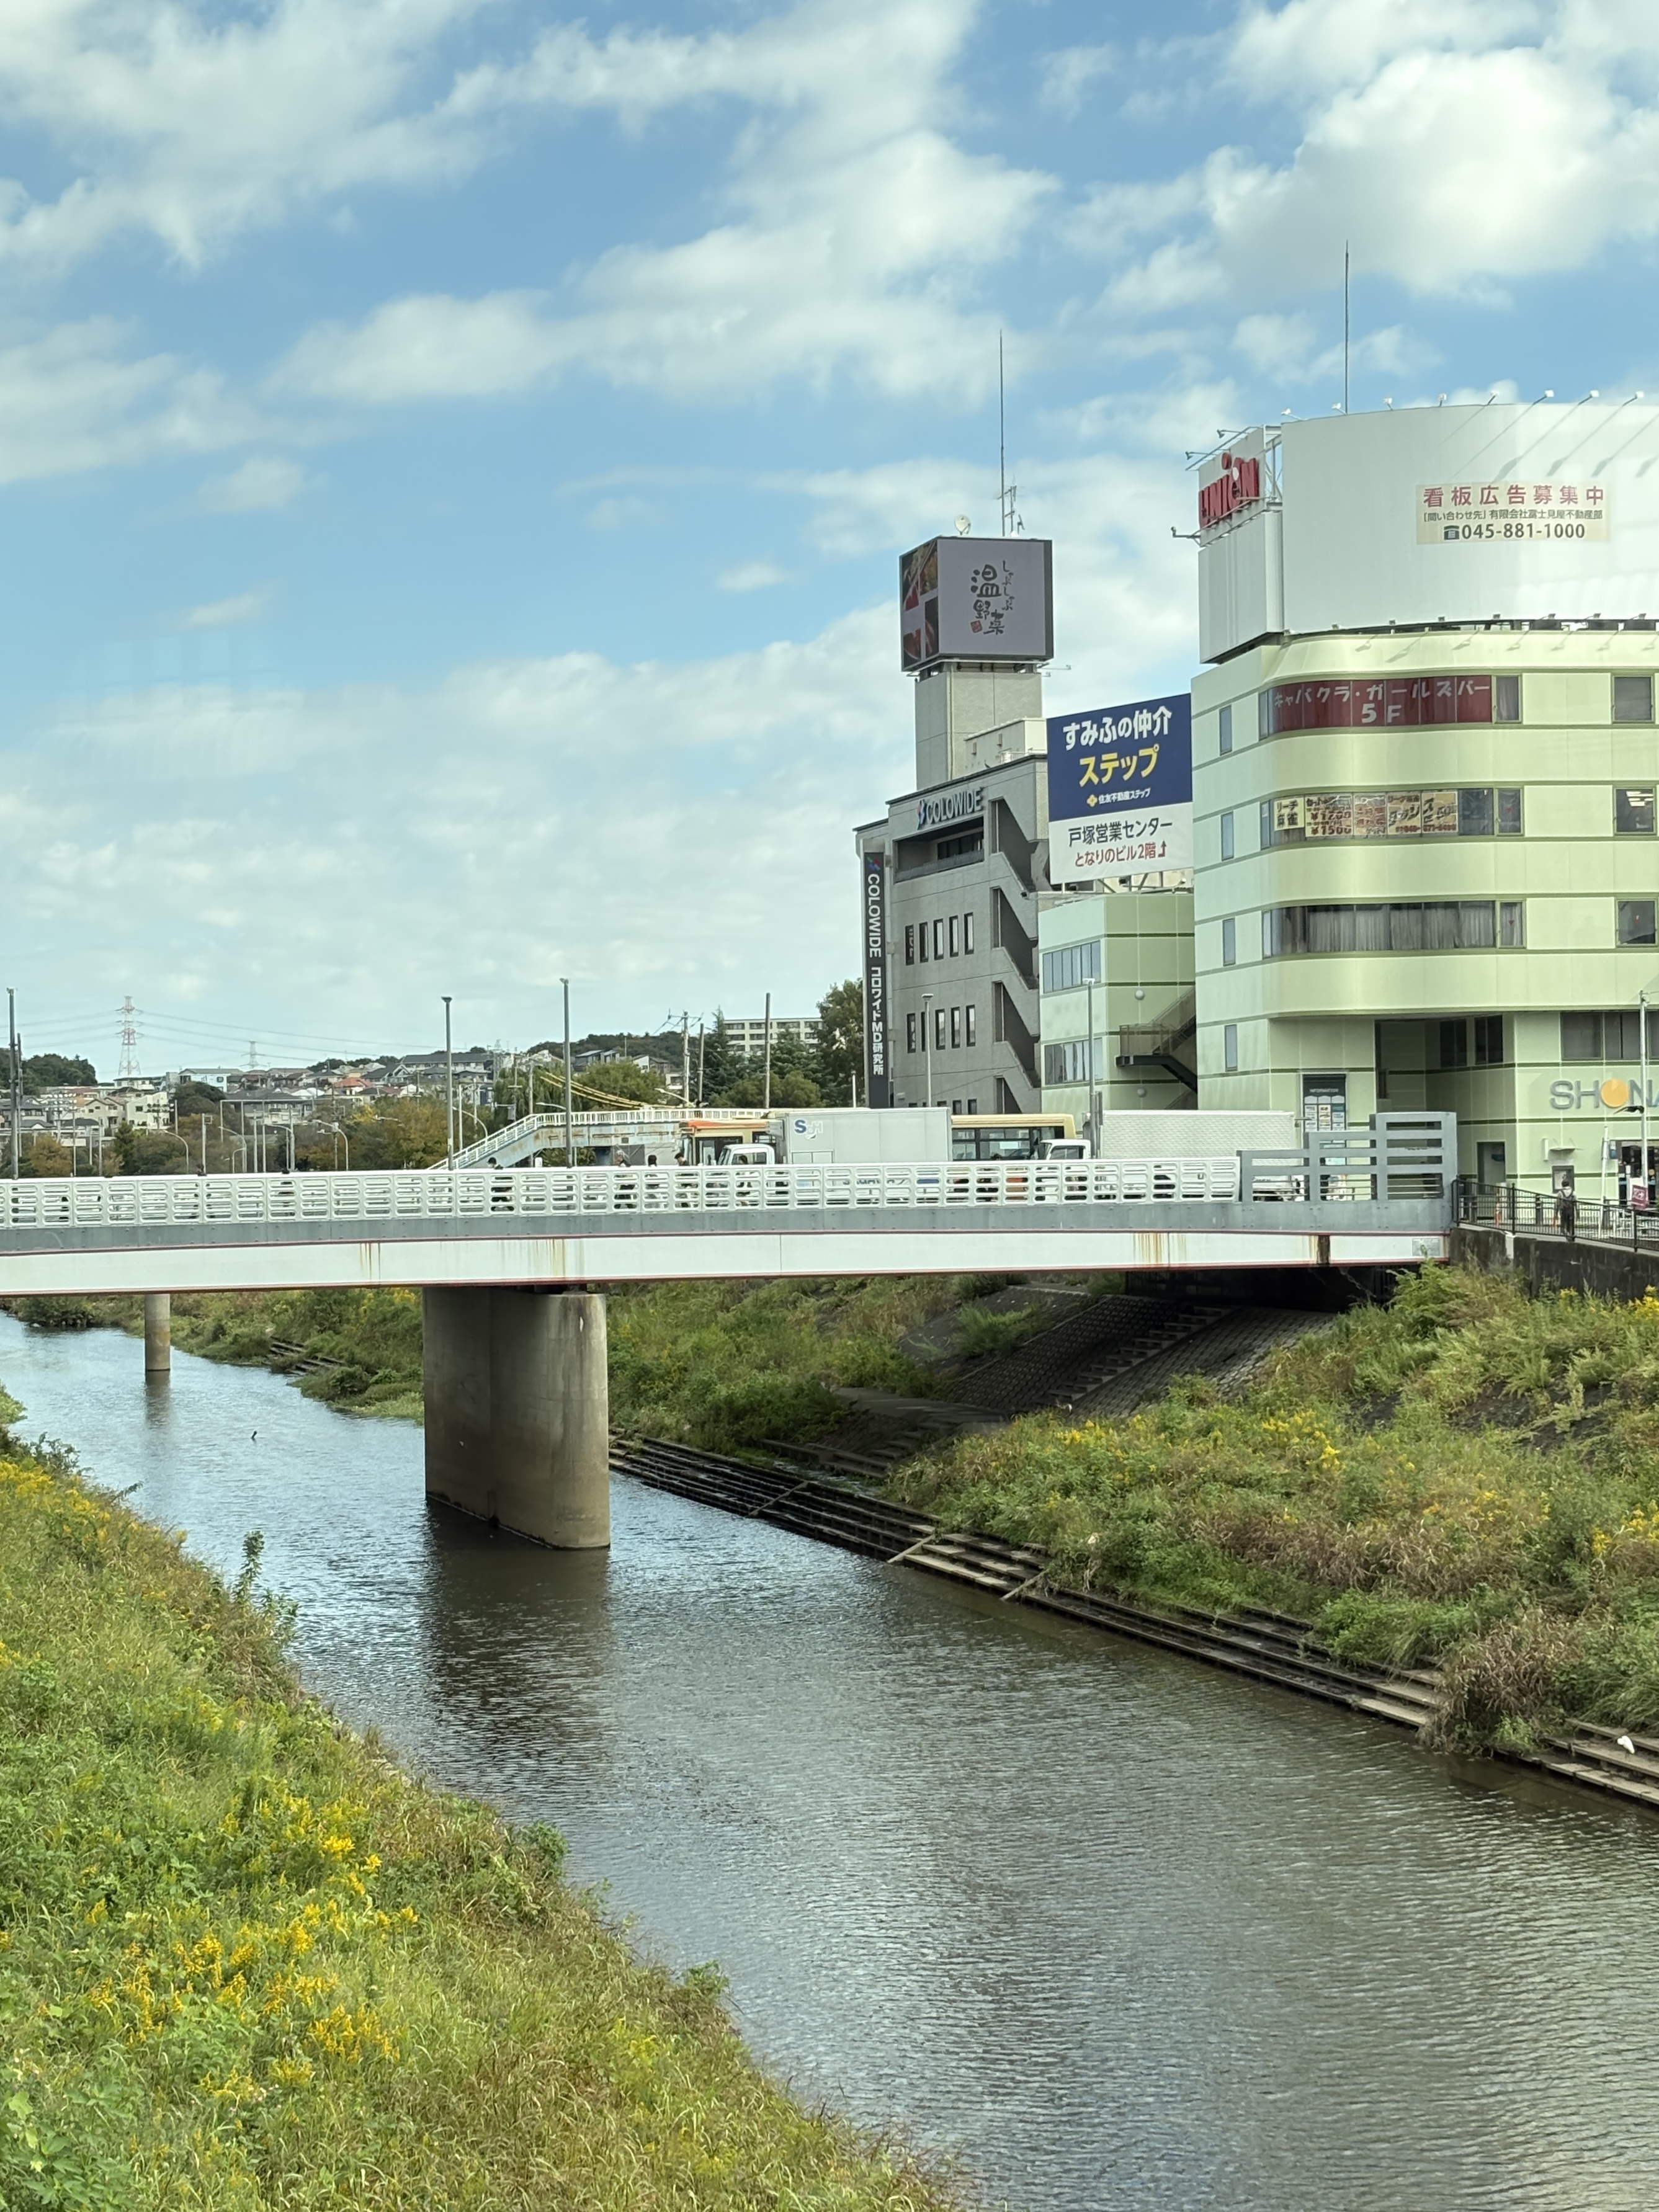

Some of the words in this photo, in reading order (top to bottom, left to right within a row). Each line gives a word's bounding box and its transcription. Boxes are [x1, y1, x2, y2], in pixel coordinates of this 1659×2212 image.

[1423, 484, 1604, 507] 看板広告募集中
[1462, 523, 1585, 539] 045-881-1000
[970, 564, 1005, 635] 温野菜
[1063, 706, 1172, 751] すみふの仲介
[1079, 744, 1159, 787] ステップ
[926, 788, 982, 824] COLOWIDE
[1277, 800, 1298, 812] リーチ
[1068, 818, 1173, 847] 戸塚営業センター
[1075, 842, 1156, 867] となりのビル2階
[868, 873, 882, 958] COLOWIDE
[871, 966, 883, 1075] コロワイドMD研究所
